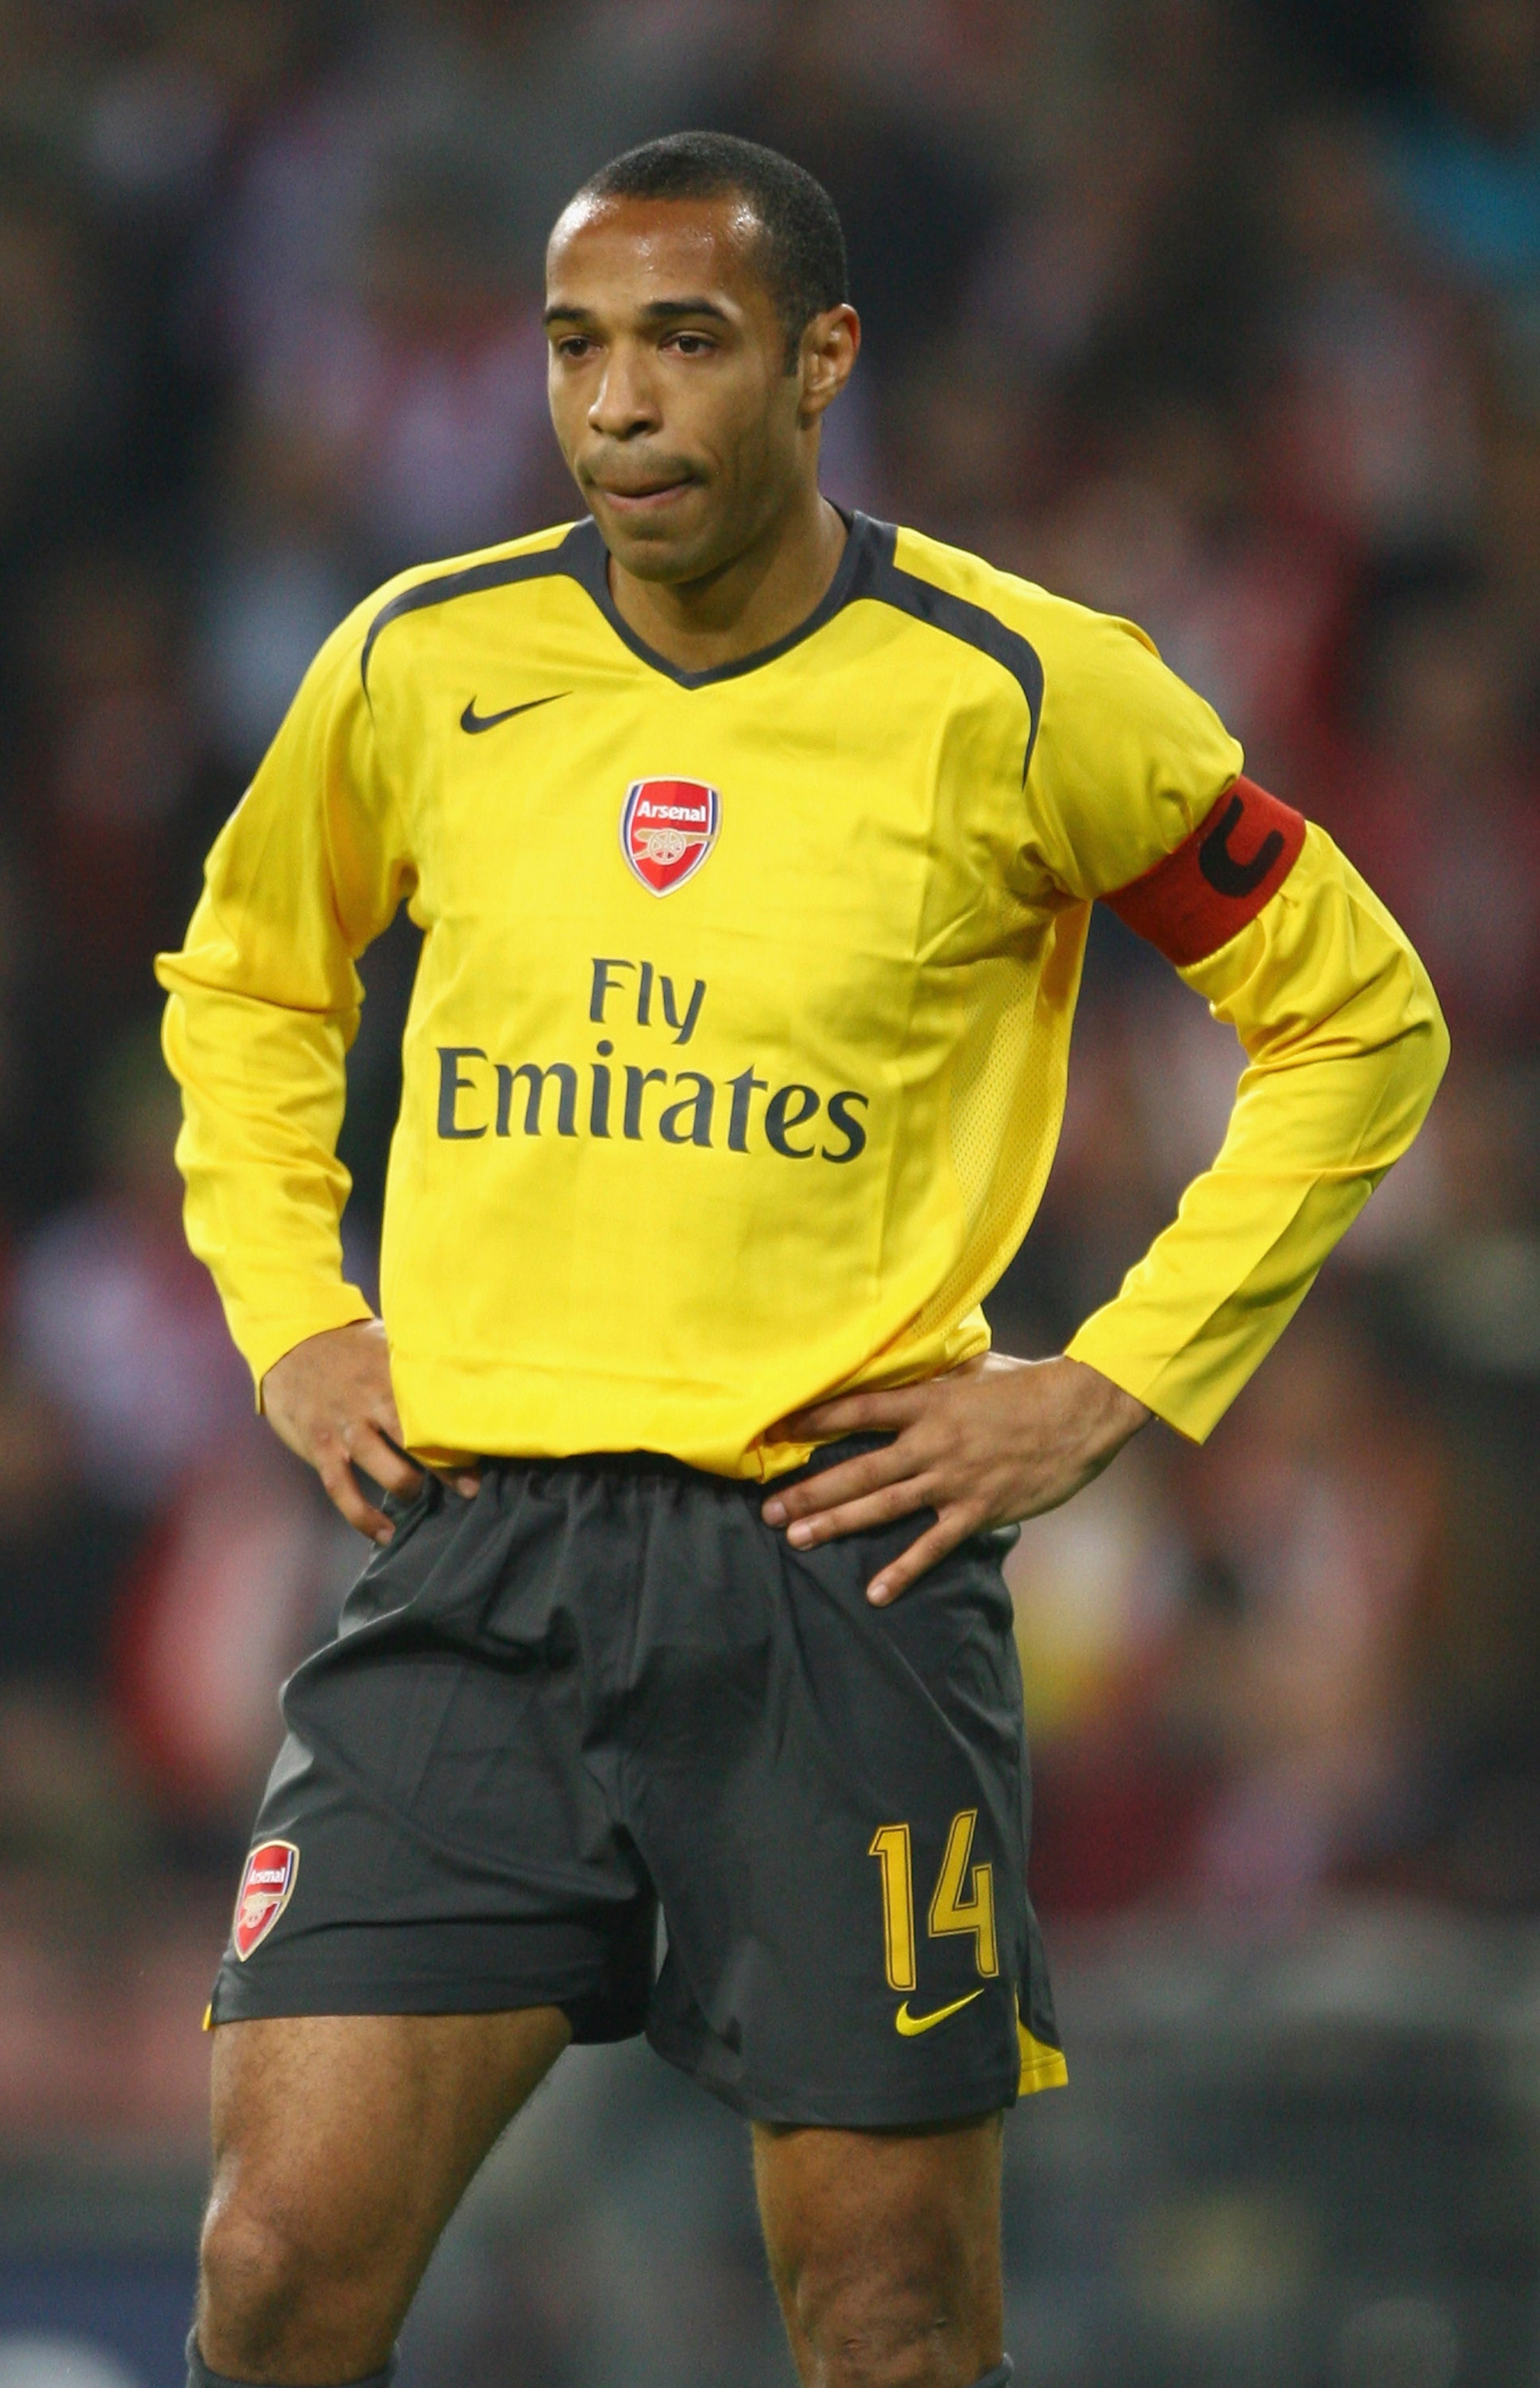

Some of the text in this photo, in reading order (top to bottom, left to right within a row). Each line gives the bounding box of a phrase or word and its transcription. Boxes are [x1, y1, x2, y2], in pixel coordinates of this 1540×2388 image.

[636, 800, 706, 822] Arsenal
[1198, 794, 1285, 898] C
[589, 957, 707, 1045] Fly
[436, 1039, 870, 1164] Emirates
[868, 1808, 1000, 1992] 14
